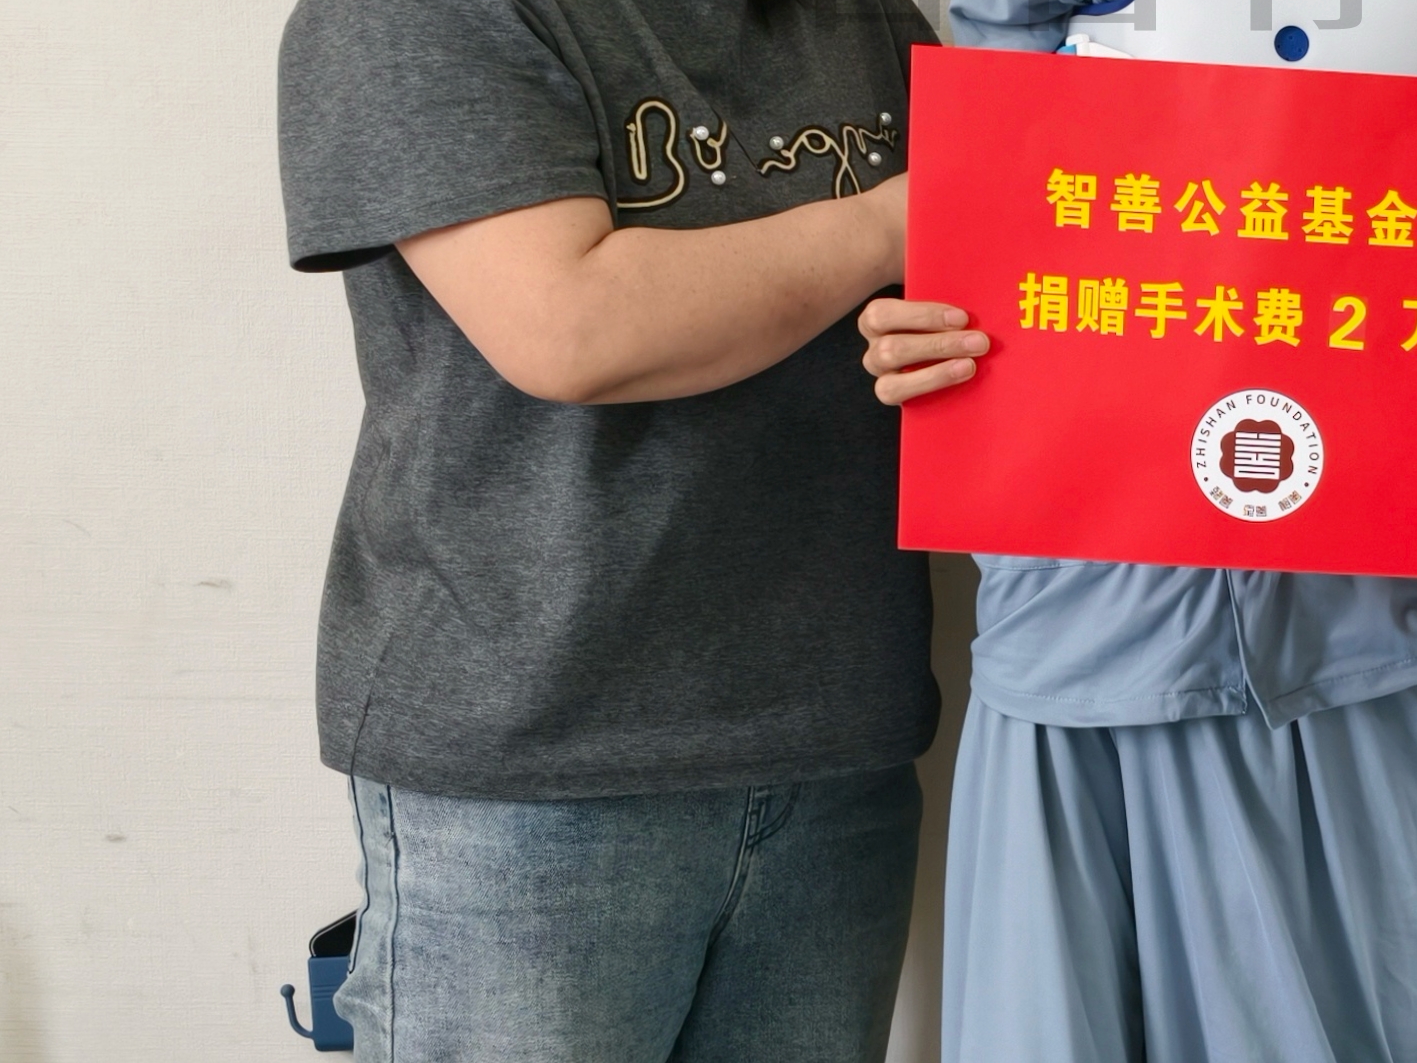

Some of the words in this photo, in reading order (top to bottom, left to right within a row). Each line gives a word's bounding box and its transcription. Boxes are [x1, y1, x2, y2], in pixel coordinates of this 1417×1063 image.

[1018, 272, 1304, 347] 捐赠手术费
[1329, 296, 1367, 350] 2
[1195, 399, 1237, 469] ZHISHAN
[1246, 394, 1320, 475] FOUNDATION
